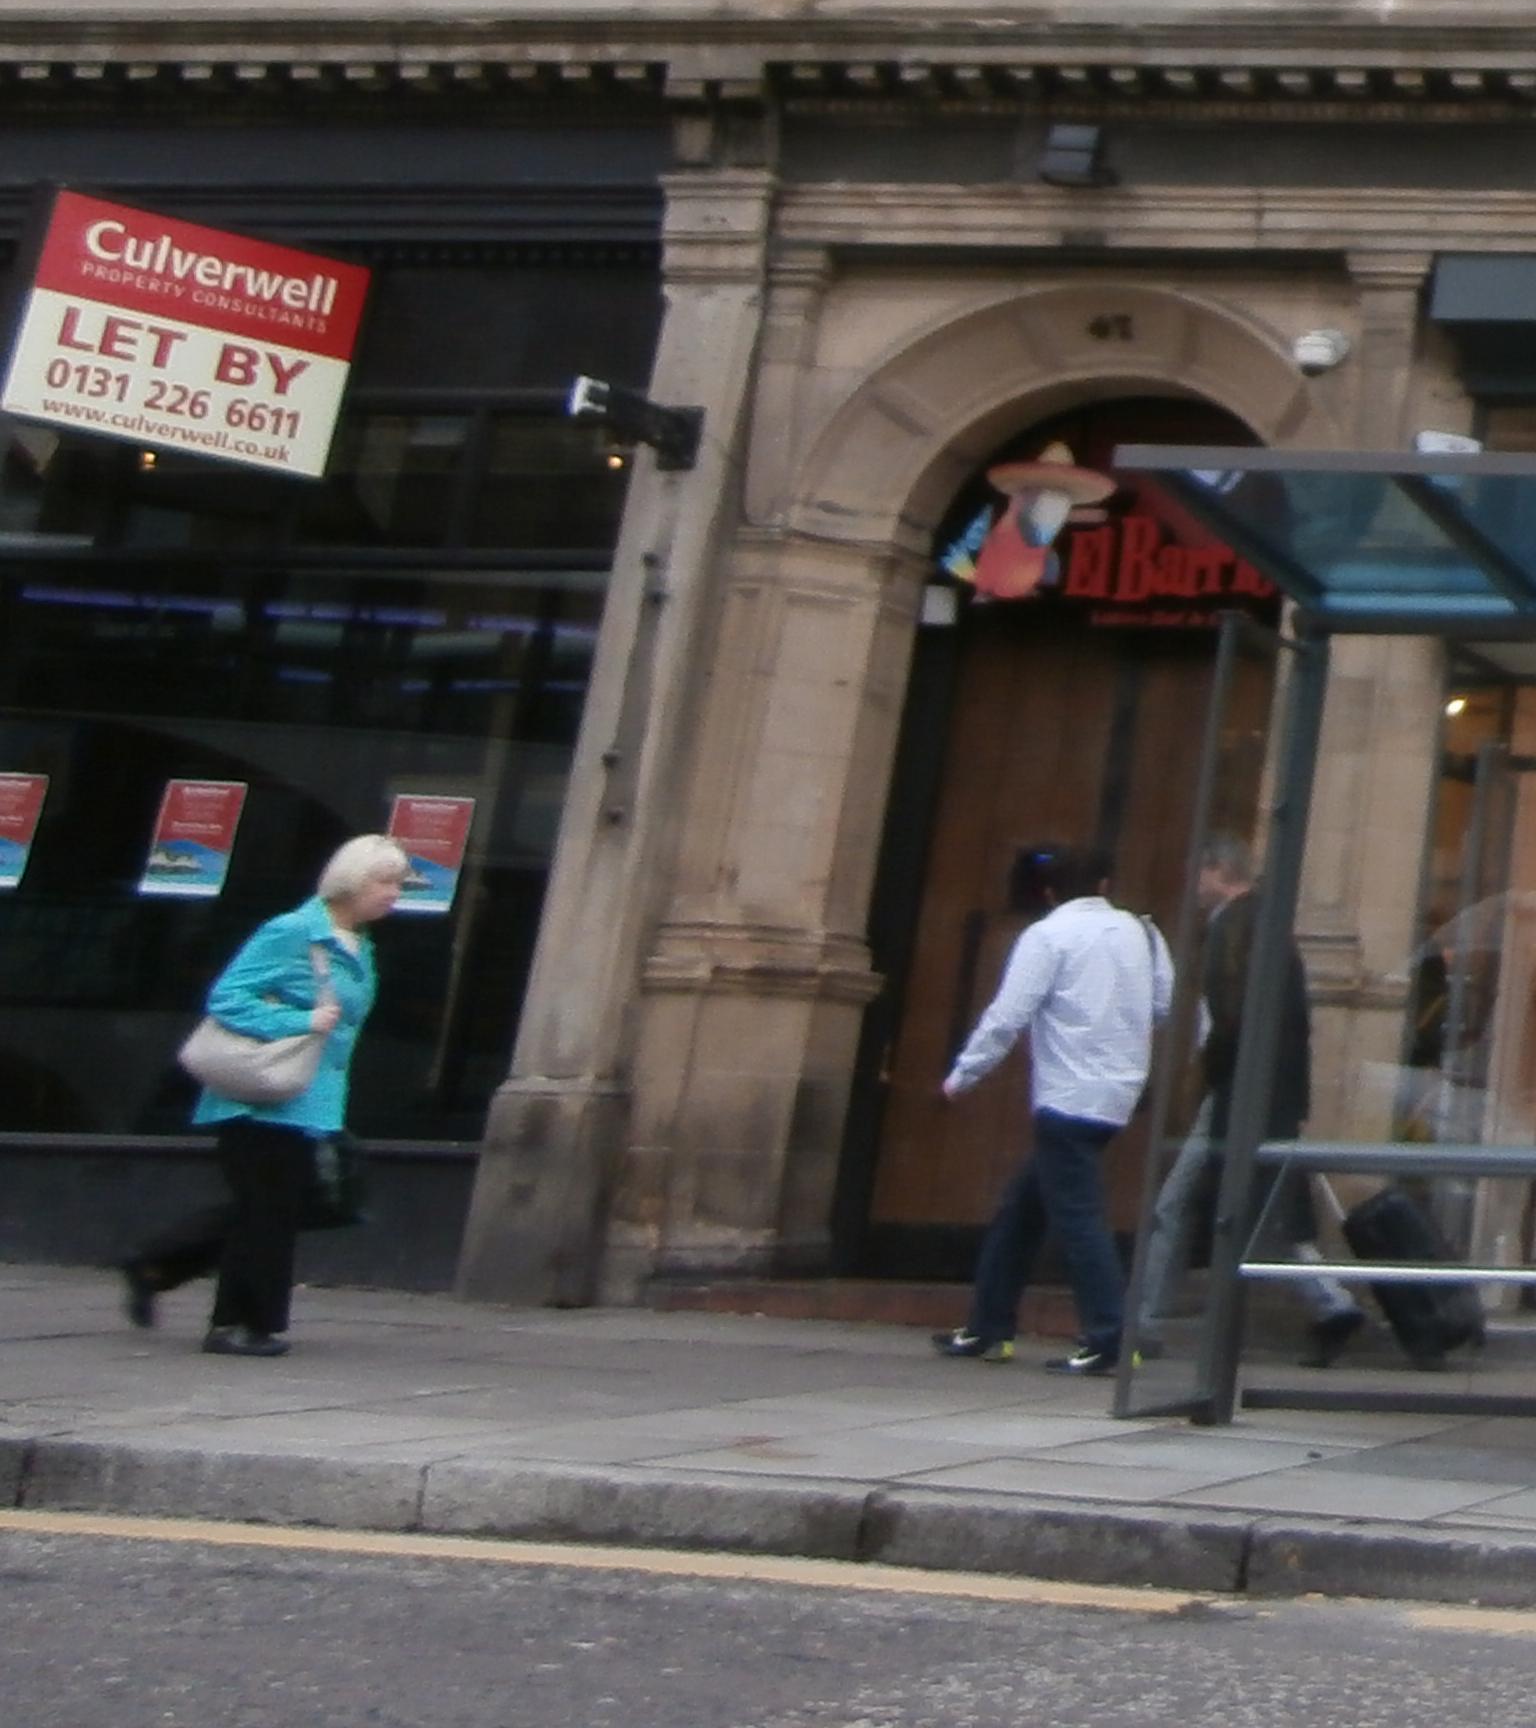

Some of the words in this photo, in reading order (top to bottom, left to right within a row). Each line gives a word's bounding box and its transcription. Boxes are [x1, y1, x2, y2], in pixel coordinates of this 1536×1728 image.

[82, 262, 184, 297] PROPERTY
[192, 290, 327, 334] CONSULTANTS
[85, 219, 338, 316] Culverwell
[57, 305, 188, 370] LET
[214, 342, 311, 396] BY
[42, 396, 291, 464] www.culverwell.co.uk
[45, 357, 131, 404] 0131
[144, 379, 212, 420] 226
[225, 398, 301, 440] 6611
